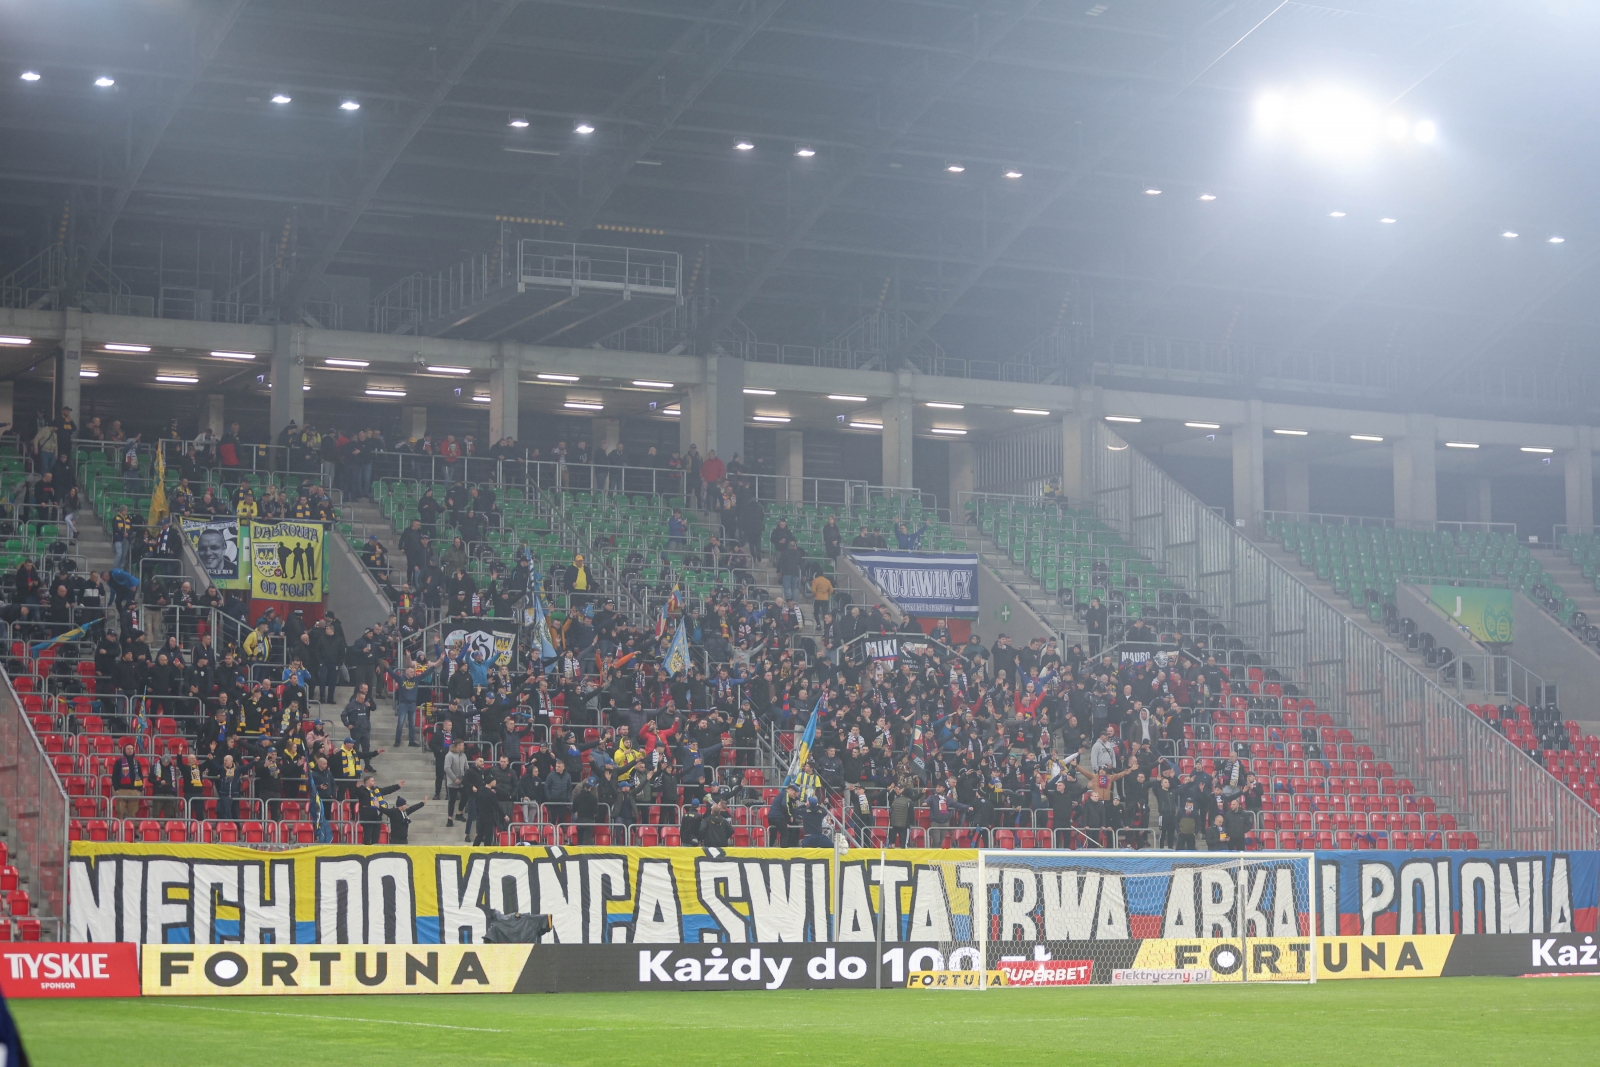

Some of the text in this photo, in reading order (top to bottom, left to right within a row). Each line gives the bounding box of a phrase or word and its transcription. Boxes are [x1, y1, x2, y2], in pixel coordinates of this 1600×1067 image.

[281, 582, 314, 597] TOUR
[874, 567, 973, 599] KUJAWIACY
[1453, 596, 1462, 617] J
[865, 639, 898, 658] MIKI
[1121, 651, 1151, 663] MAURO
[70, 855, 295, 944] NIECH
[315, 852, 414, 944] DO
[436, 846, 683, 943] KOŃCA
[695, 847, 953, 942] ŚWIATA
[955, 861, 1132, 940] TRWA
[1162, 862, 1300, 938] ARKA
[1316, 859, 1341, 936] I
[1174, 942, 1424, 975] FORTUNA
[1532, 936, 1600, 967] Każ
[4, 953, 110, 979] TYSKIE
[160, 951, 490, 987] FORTUNA
[639, 947, 792, 990] Każdy
[807, 948, 867, 980] do
[1003, 966, 1088, 983] SUPERBET
[1115, 971, 1208, 983] elektryczny.pl
[40, 982, 76, 990] SPONSOR
